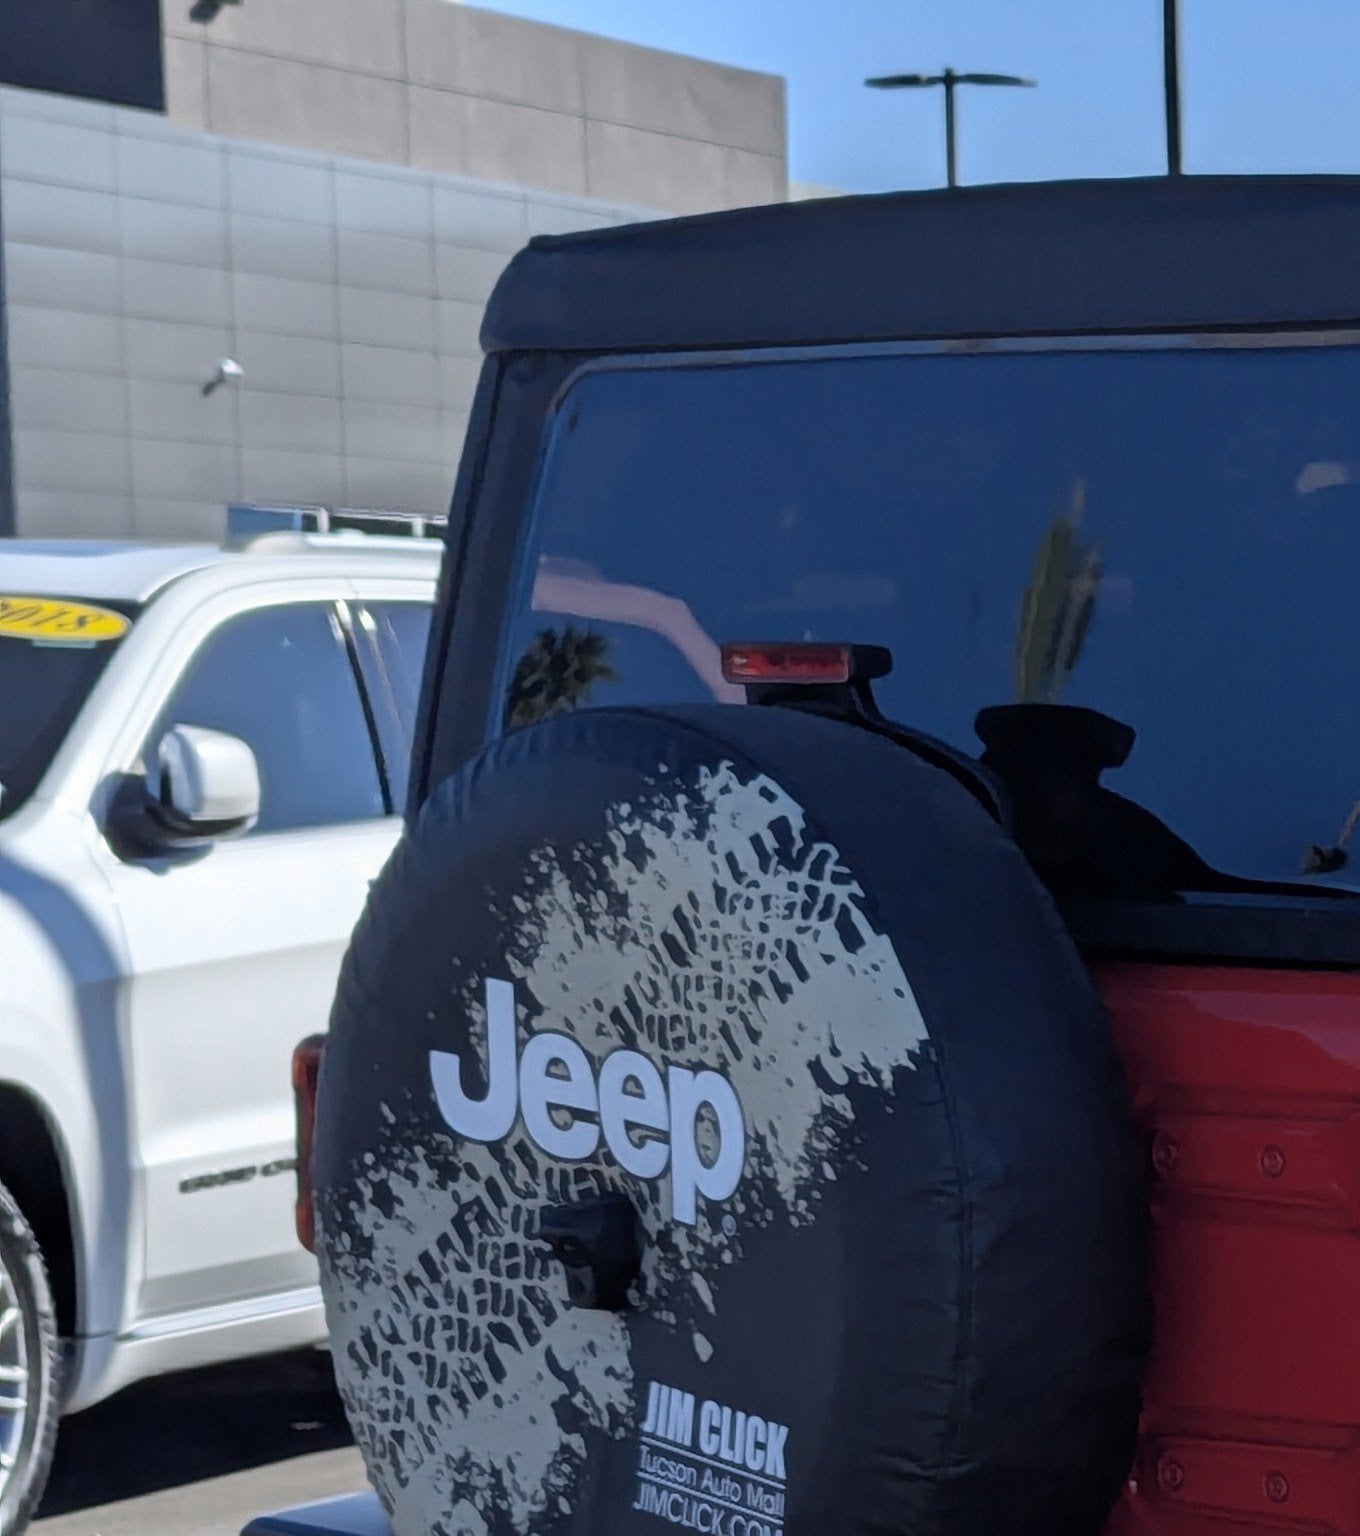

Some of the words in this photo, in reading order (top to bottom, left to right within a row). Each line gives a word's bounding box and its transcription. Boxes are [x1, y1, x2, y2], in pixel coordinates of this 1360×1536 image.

[429, 977, 746, 1226] Jeep
[638, 1380, 696, 1447] JIM
[700, 1399, 790, 1480] CLICK
[640, 1445, 698, 1487] Tucson
[701, 1467, 743, 1503] Auto
[746, 1482, 786, 1518] Mall
